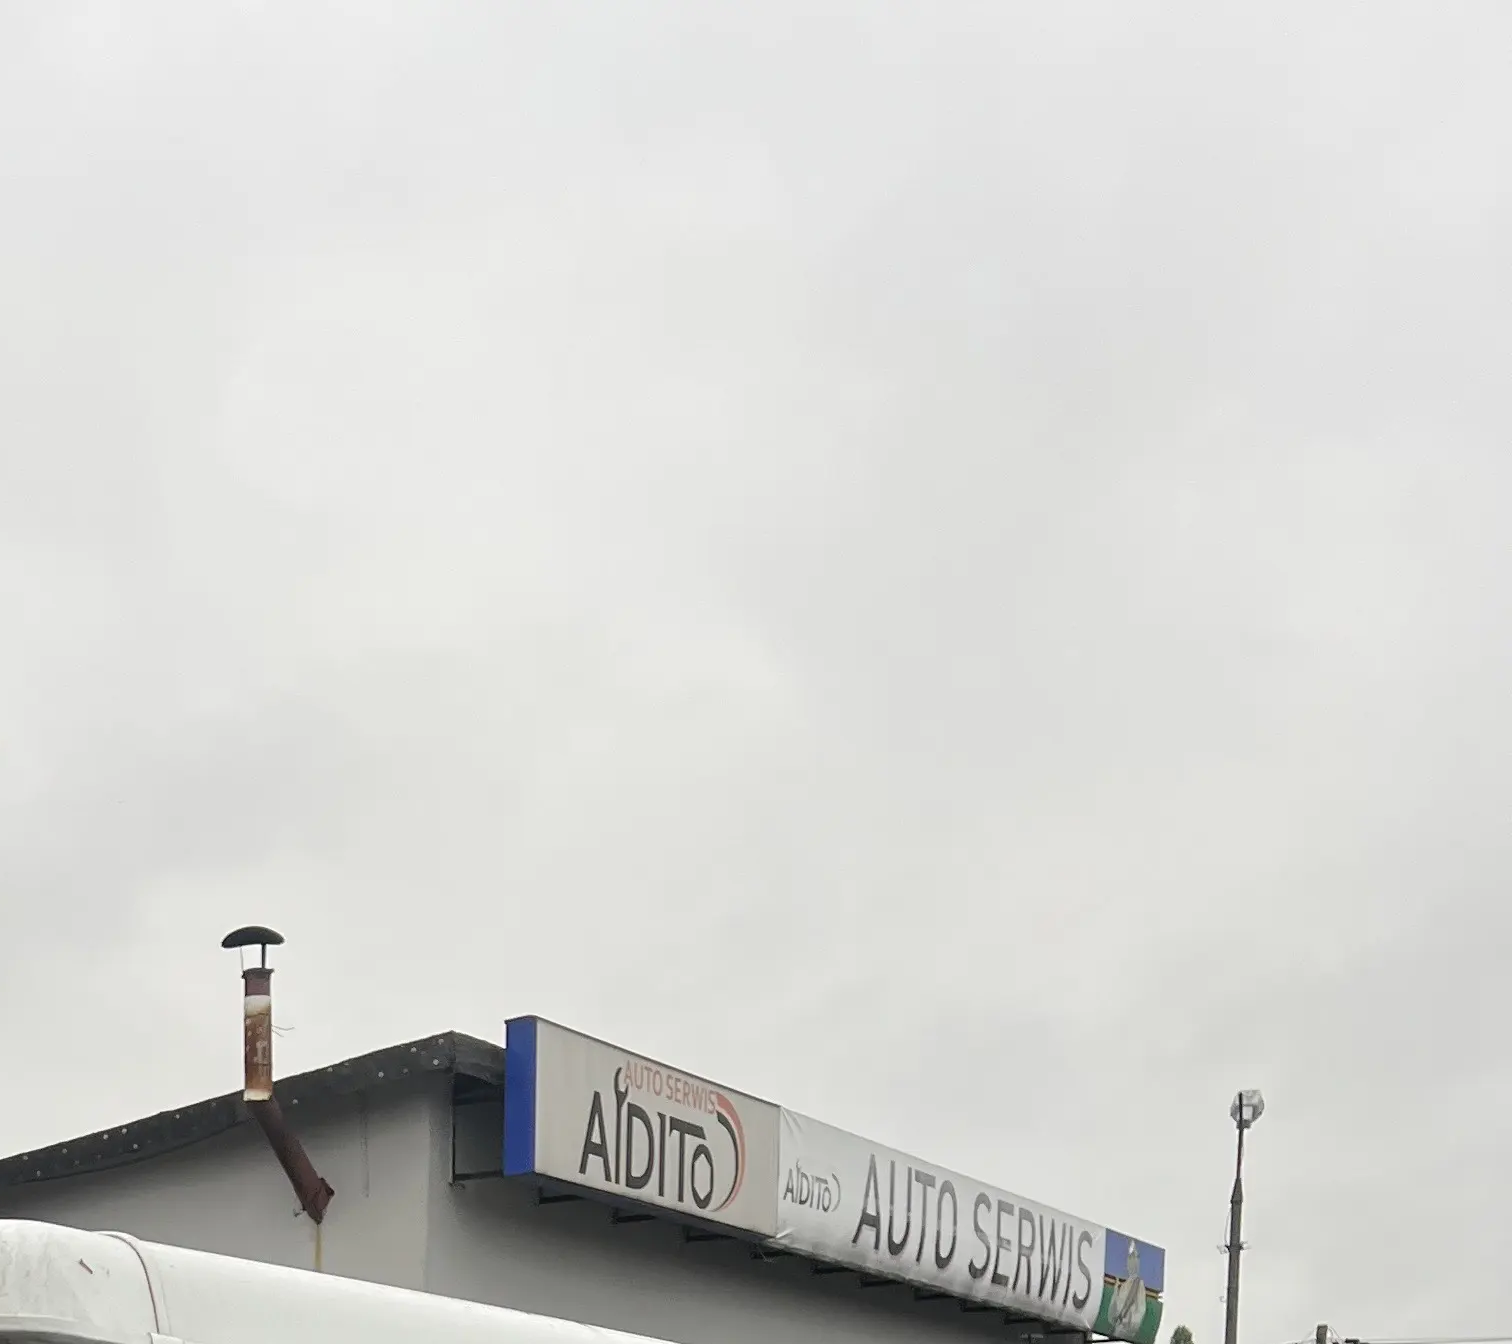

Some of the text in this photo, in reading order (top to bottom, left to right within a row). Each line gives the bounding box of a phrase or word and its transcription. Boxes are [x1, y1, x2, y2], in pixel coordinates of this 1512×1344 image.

[624, 1060, 717, 1115] AUTO SERWIS
[851, 1153, 1093, 1310] AUTO SERWIS
